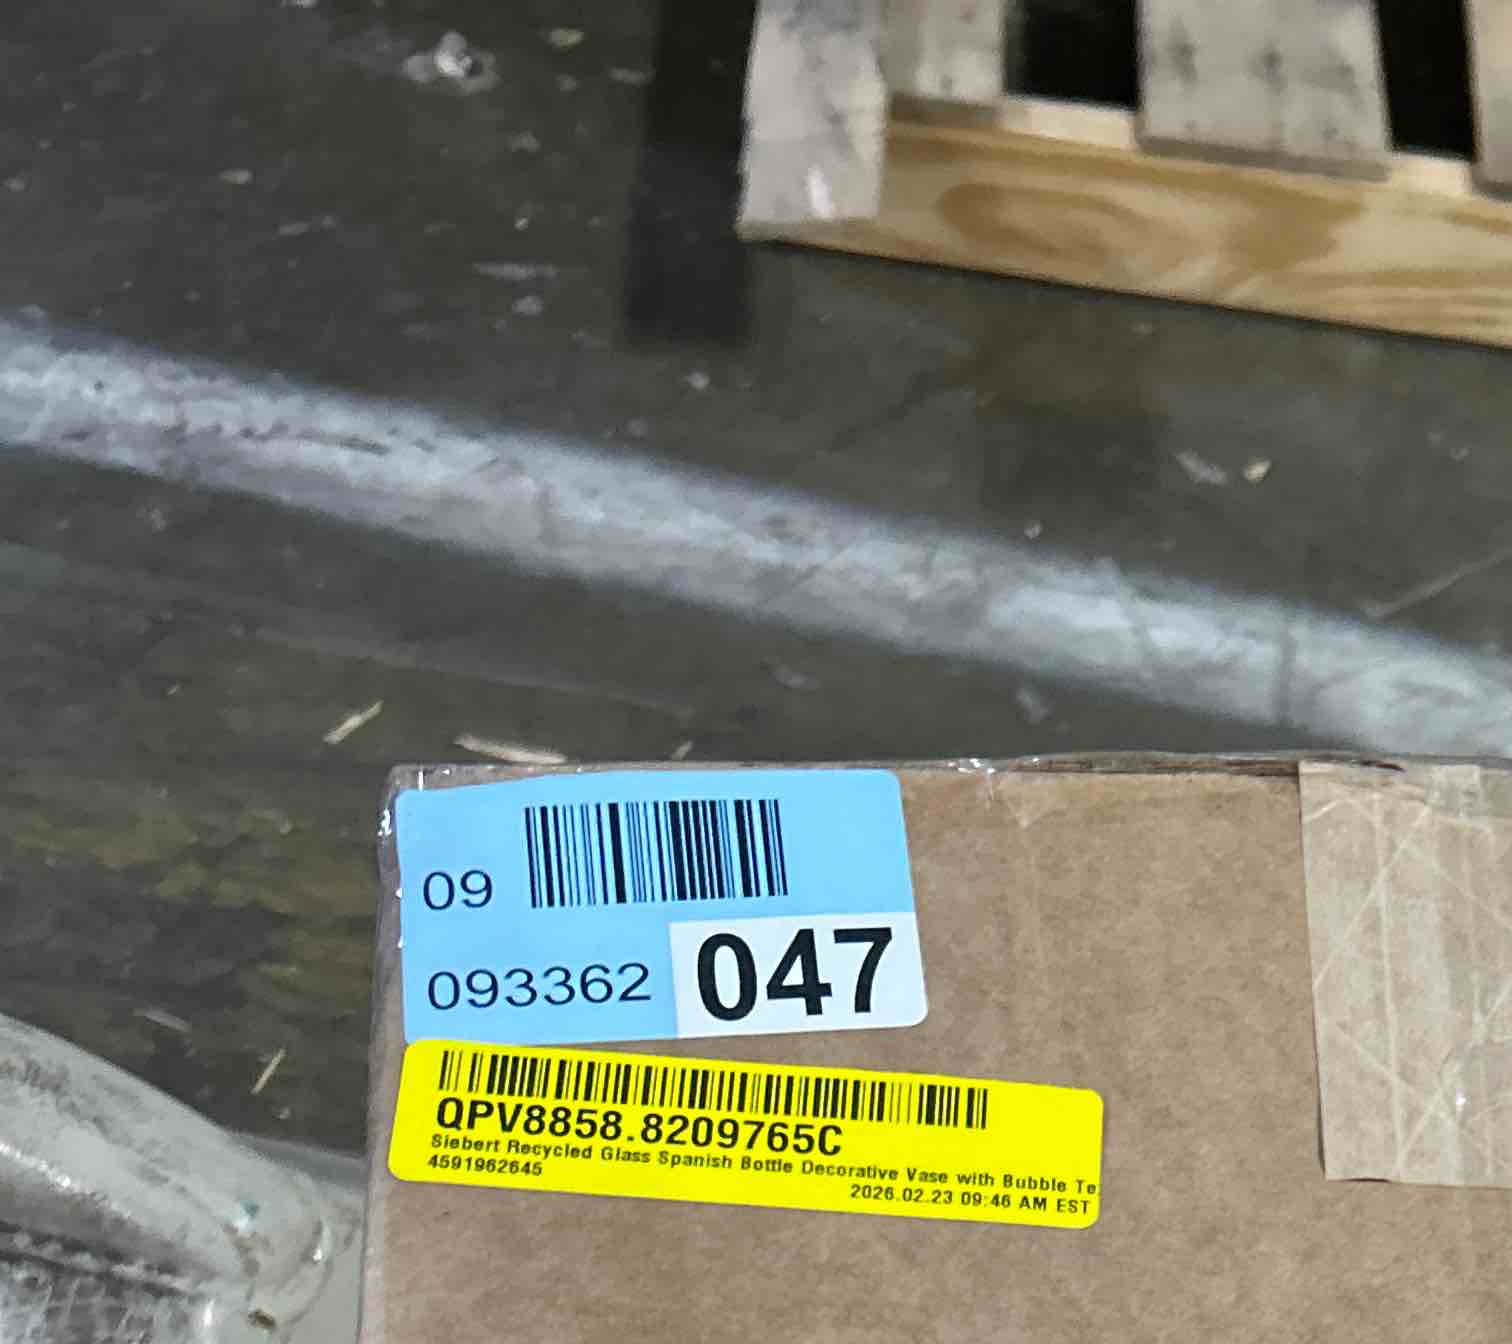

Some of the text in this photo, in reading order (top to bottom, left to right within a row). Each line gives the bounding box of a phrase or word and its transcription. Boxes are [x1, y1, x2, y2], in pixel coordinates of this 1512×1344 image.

[422, 869, 493, 911] 09
[427, 961, 652, 1010] 093362
[696, 926, 894, 1022] 047
[436, 1096, 843, 1156] QPV8858.8209765C
[431, 1134, 501, 1153] Siebert
[507, 1139, 592, 1161] Recycled
[601, 1146, 651, 1164] Glass
[658, 1150, 732, 1171] Spanish
[740, 1156, 793, 1174] Bottle
[801, 1160, 898, 1181] Decorative
[906, 1166, 948, 1184] Vase
[956, 1171, 995, 1187] with
[1003, 1174, 1067, 1192] Bubble
[850, 1183, 1091, 1215] 2026.02.23 09:46 AM EST
